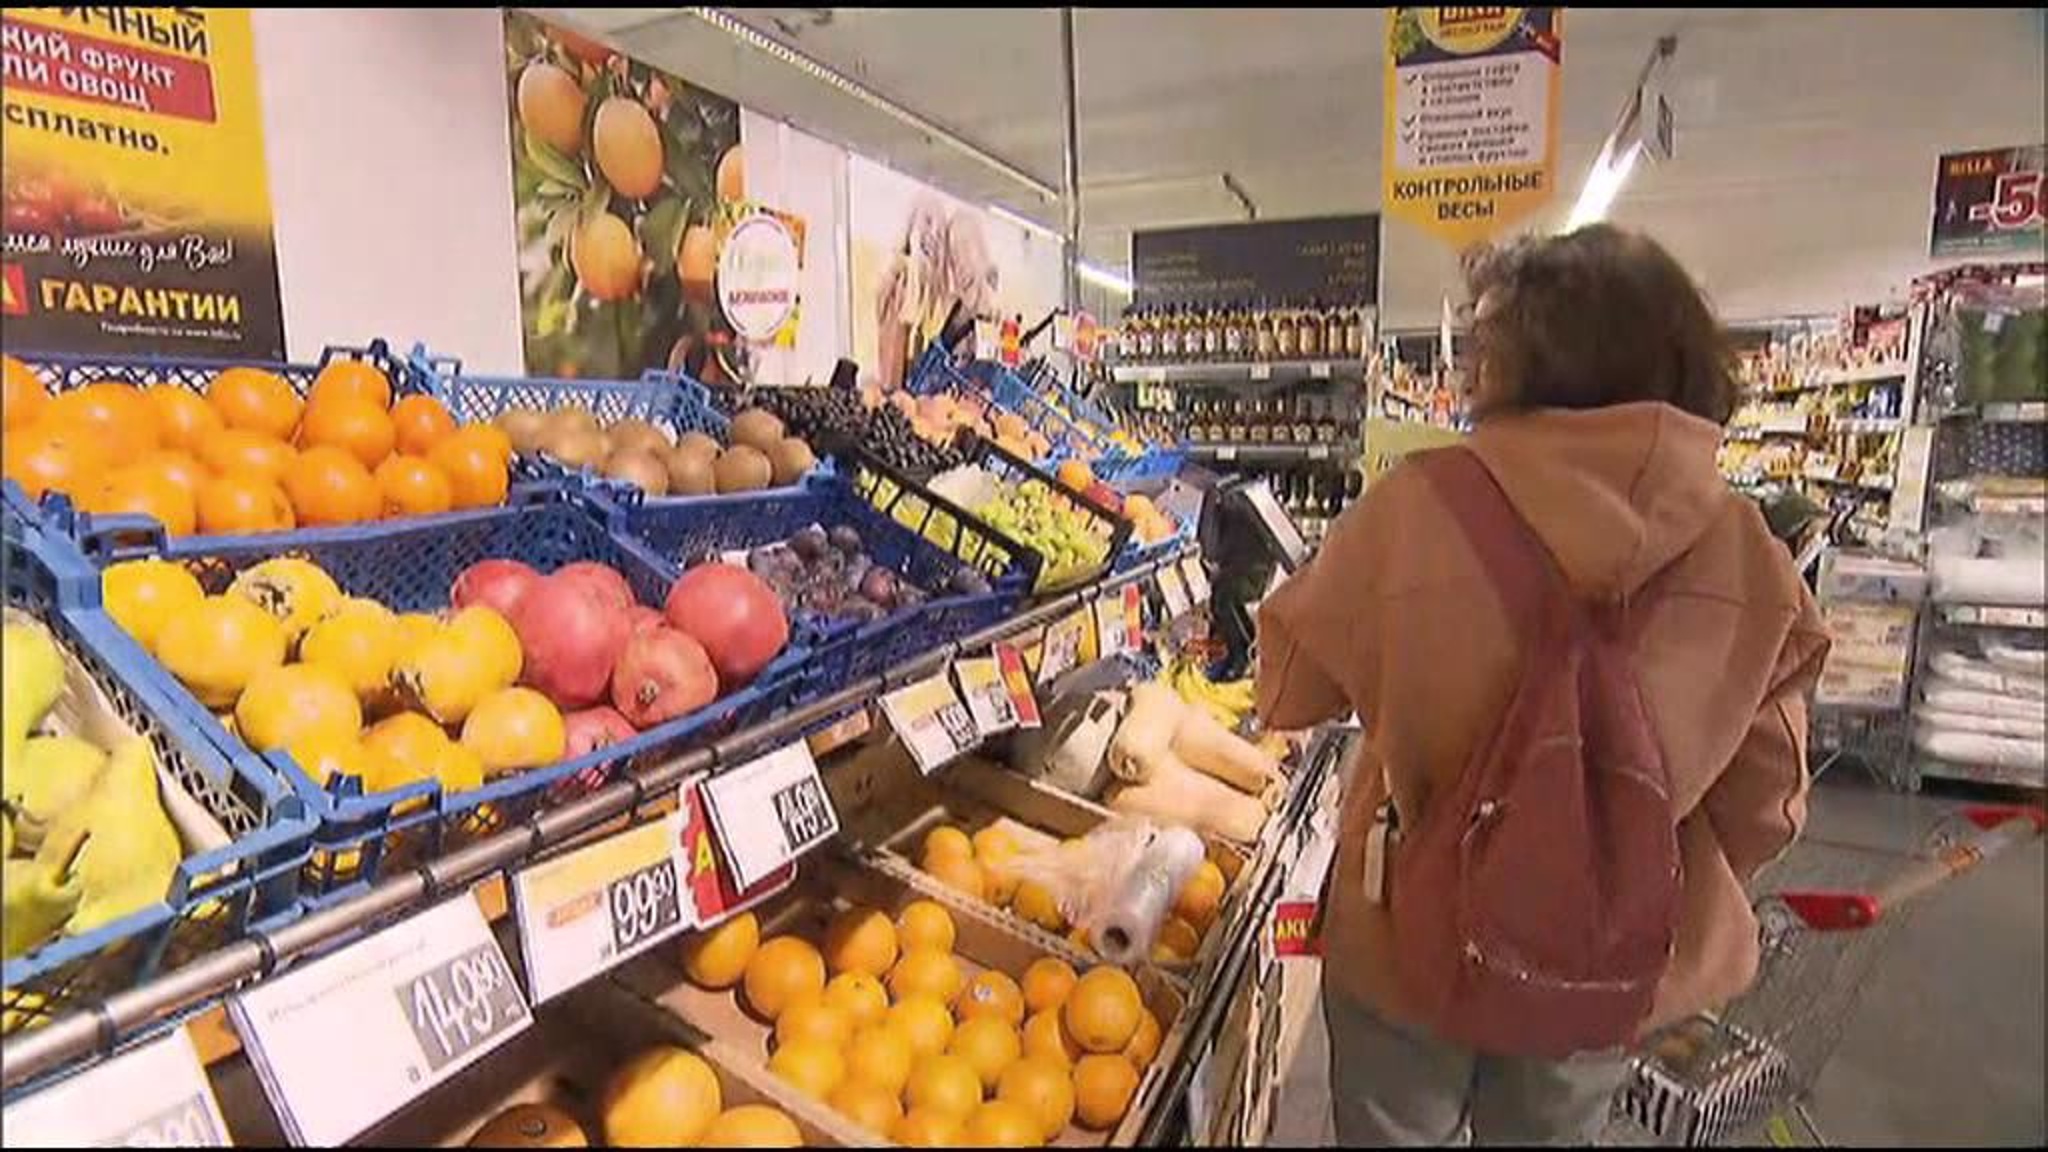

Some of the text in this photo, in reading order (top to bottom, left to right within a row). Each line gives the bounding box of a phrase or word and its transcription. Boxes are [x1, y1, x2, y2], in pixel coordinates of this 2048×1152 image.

[60, 67, 151, 112] ОВОЩ
[81, 46, 176, 90] ФРУКТ
[1392, 171, 1545, 201] КОНТРОЛЬНЫЕ
[1437, 200, 1495, 220] ВЕСЫ
[40, 278, 241, 324] ГАРАНТИИ
